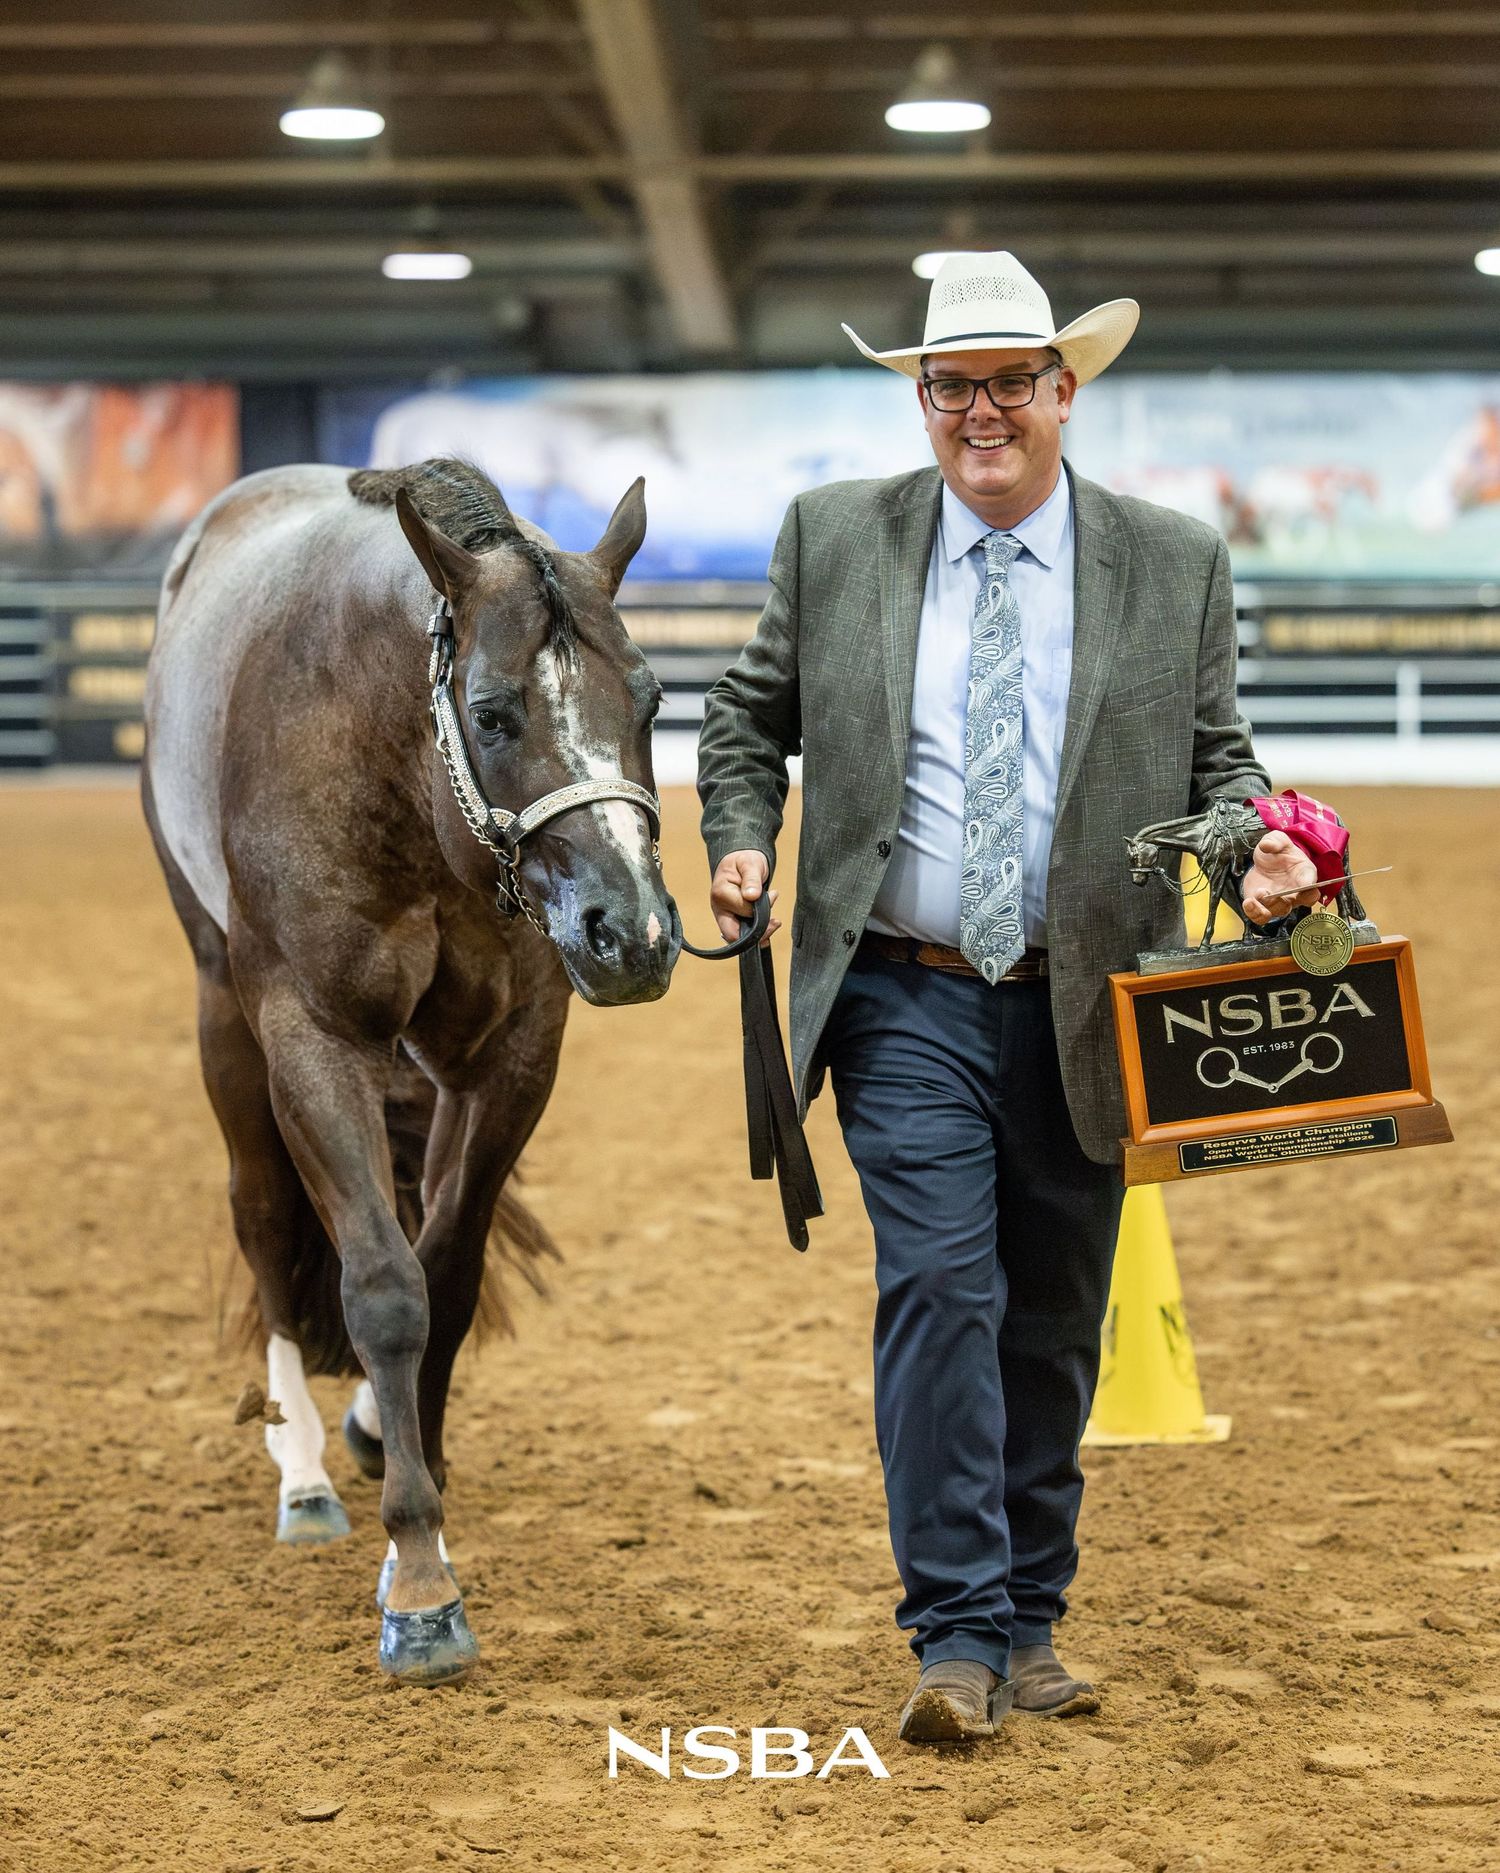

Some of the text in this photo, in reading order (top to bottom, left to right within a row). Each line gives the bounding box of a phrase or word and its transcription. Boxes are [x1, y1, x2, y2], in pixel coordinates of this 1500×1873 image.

[1301, 933, 1345, 947] NSBA
[1162, 982, 1376, 1043] NSBA
[1242, 1040, 1296, 1056] EST. 1983
[1203, 1122, 1373, 1150] Reserve World Champion
[1208, 1130, 1370, 1156] Open Performance Halter Stallions
[1203, 1152, 1234, 1161] NSBA
[1236, 1148, 1268, 1157] World
[1270, 1139, 1346, 1152] Championship
[1245, 1144, 1335, 1161] Tulsa, Oklahoma
